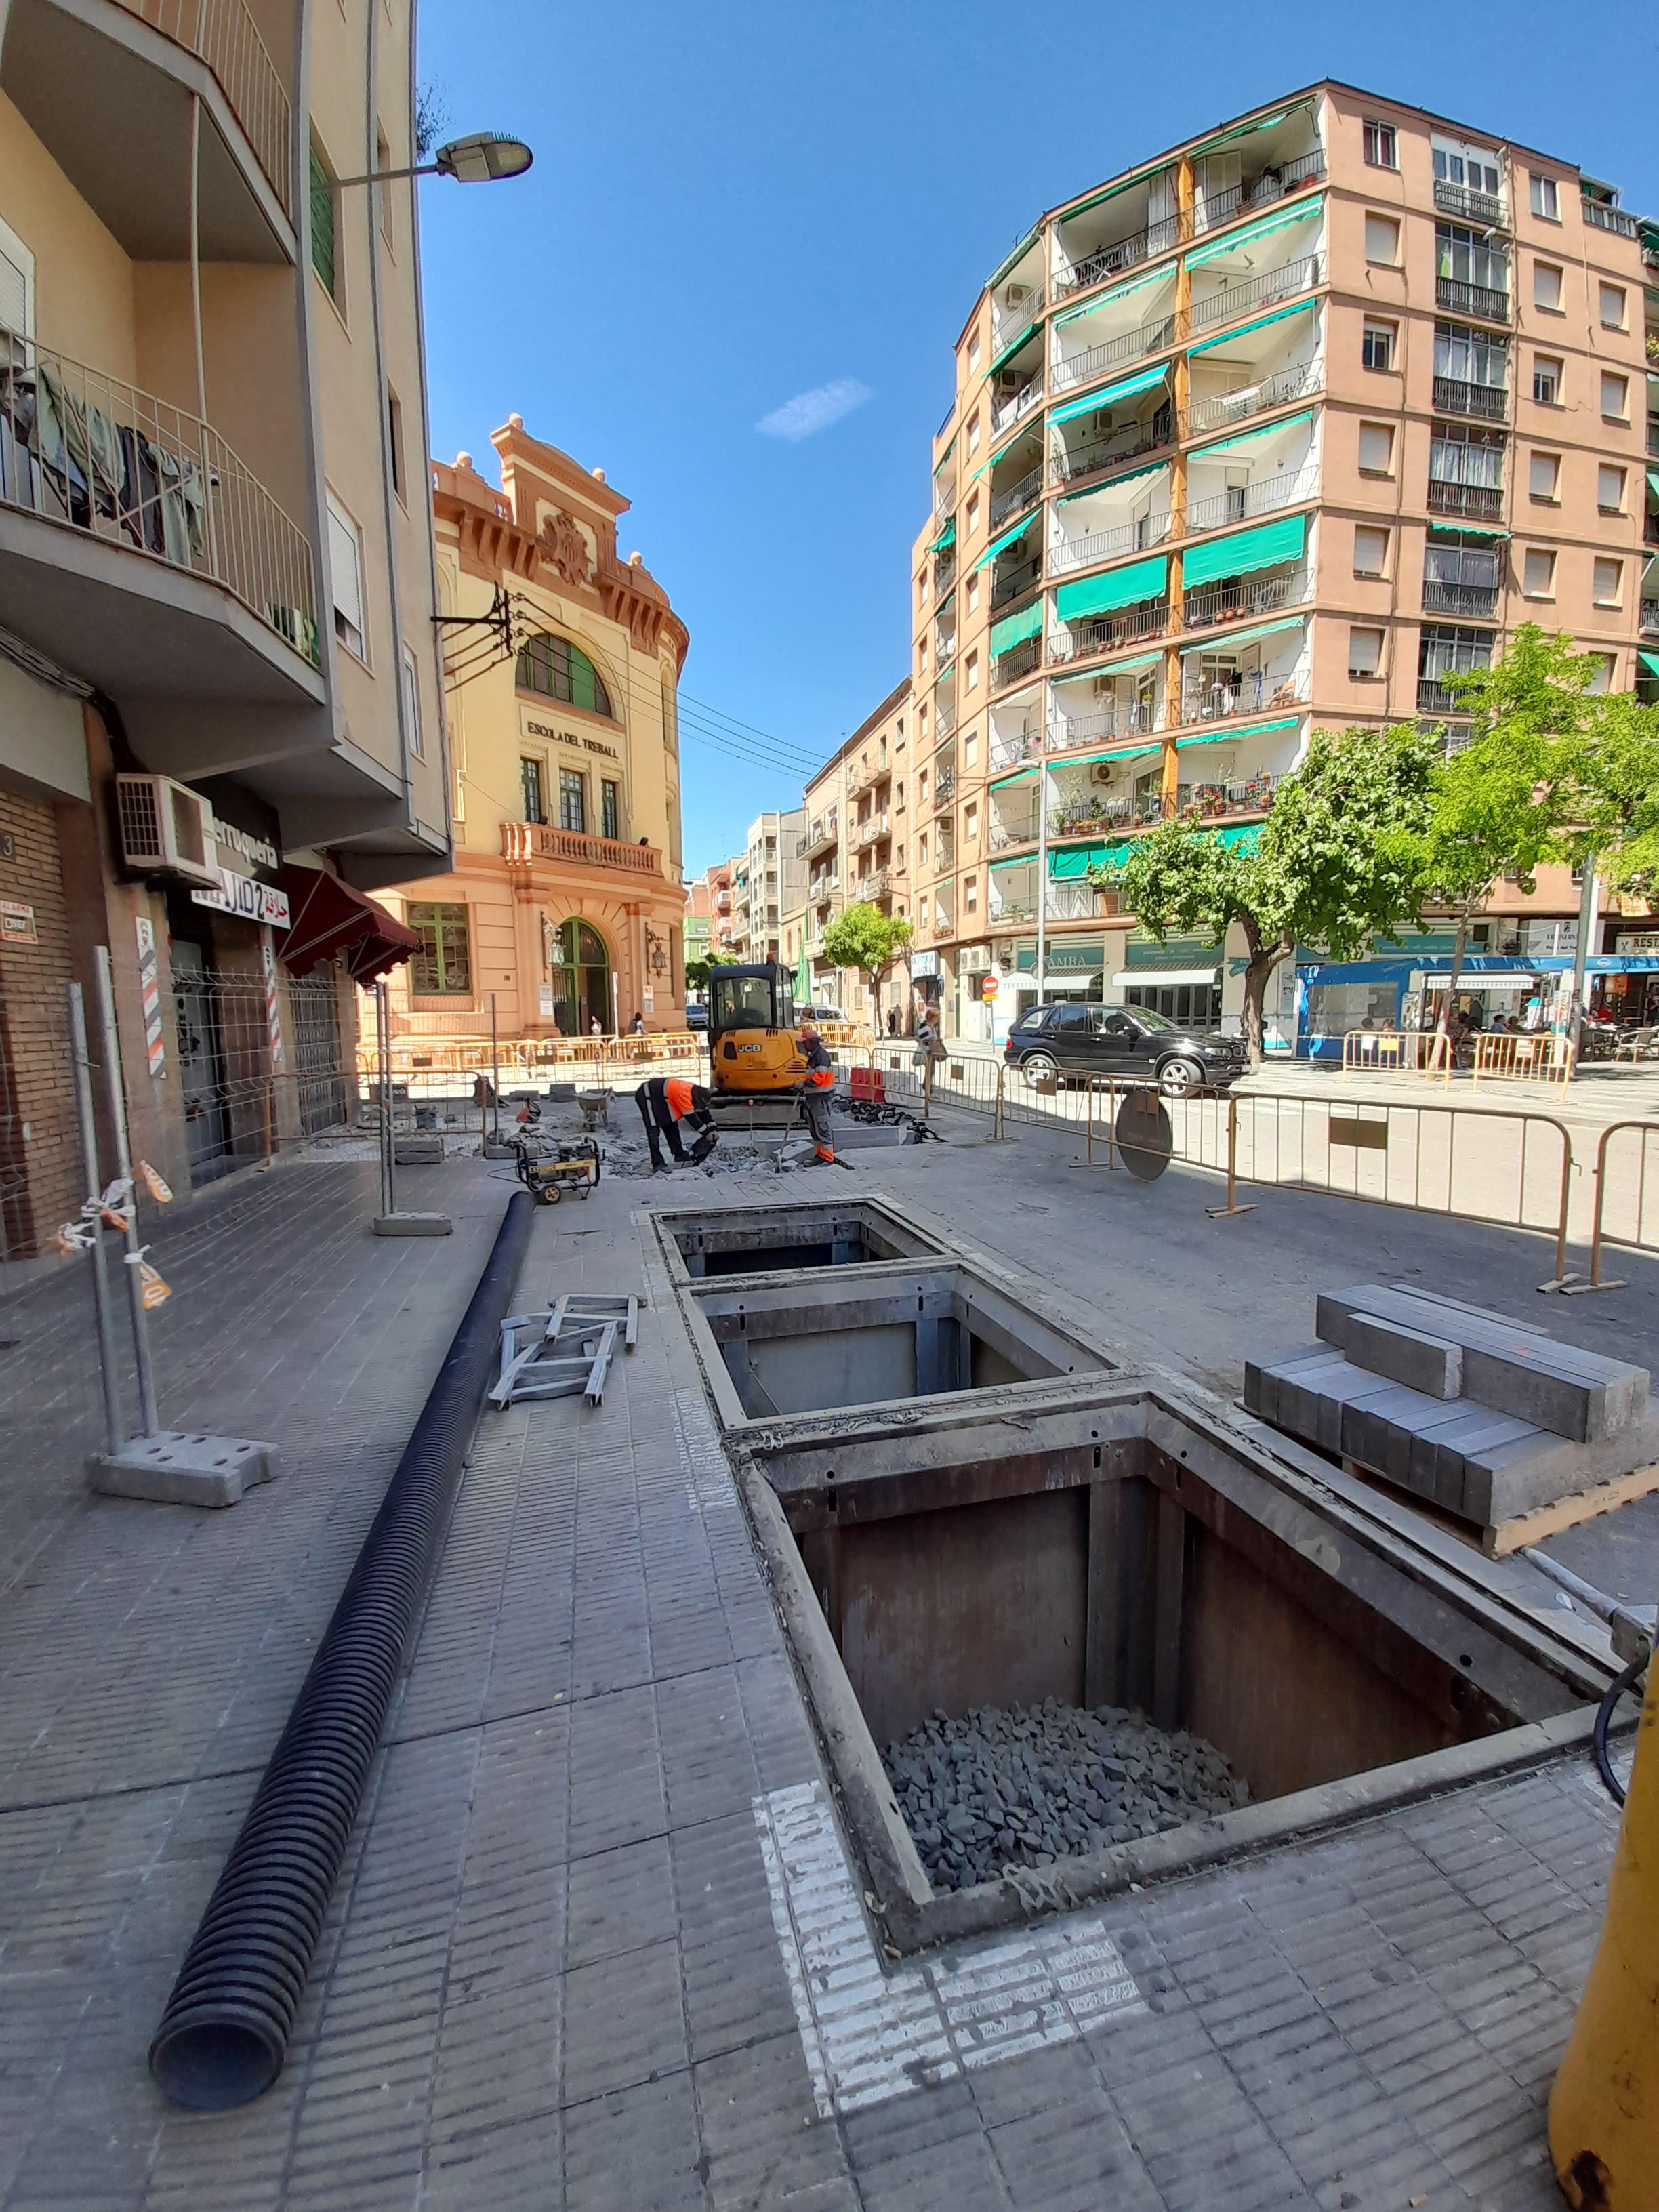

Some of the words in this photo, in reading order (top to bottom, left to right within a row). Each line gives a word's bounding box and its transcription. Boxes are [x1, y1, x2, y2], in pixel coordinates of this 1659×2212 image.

[527, 722, 563, 742] ESCOLA
[564, 733, 582, 747] DEL
[582, 739, 619, 759] TREBALL
[213, 816, 279, 869] erruqueria
[255, 884, 264, 920] 2
[738, 1044, 762, 1052] JCB
